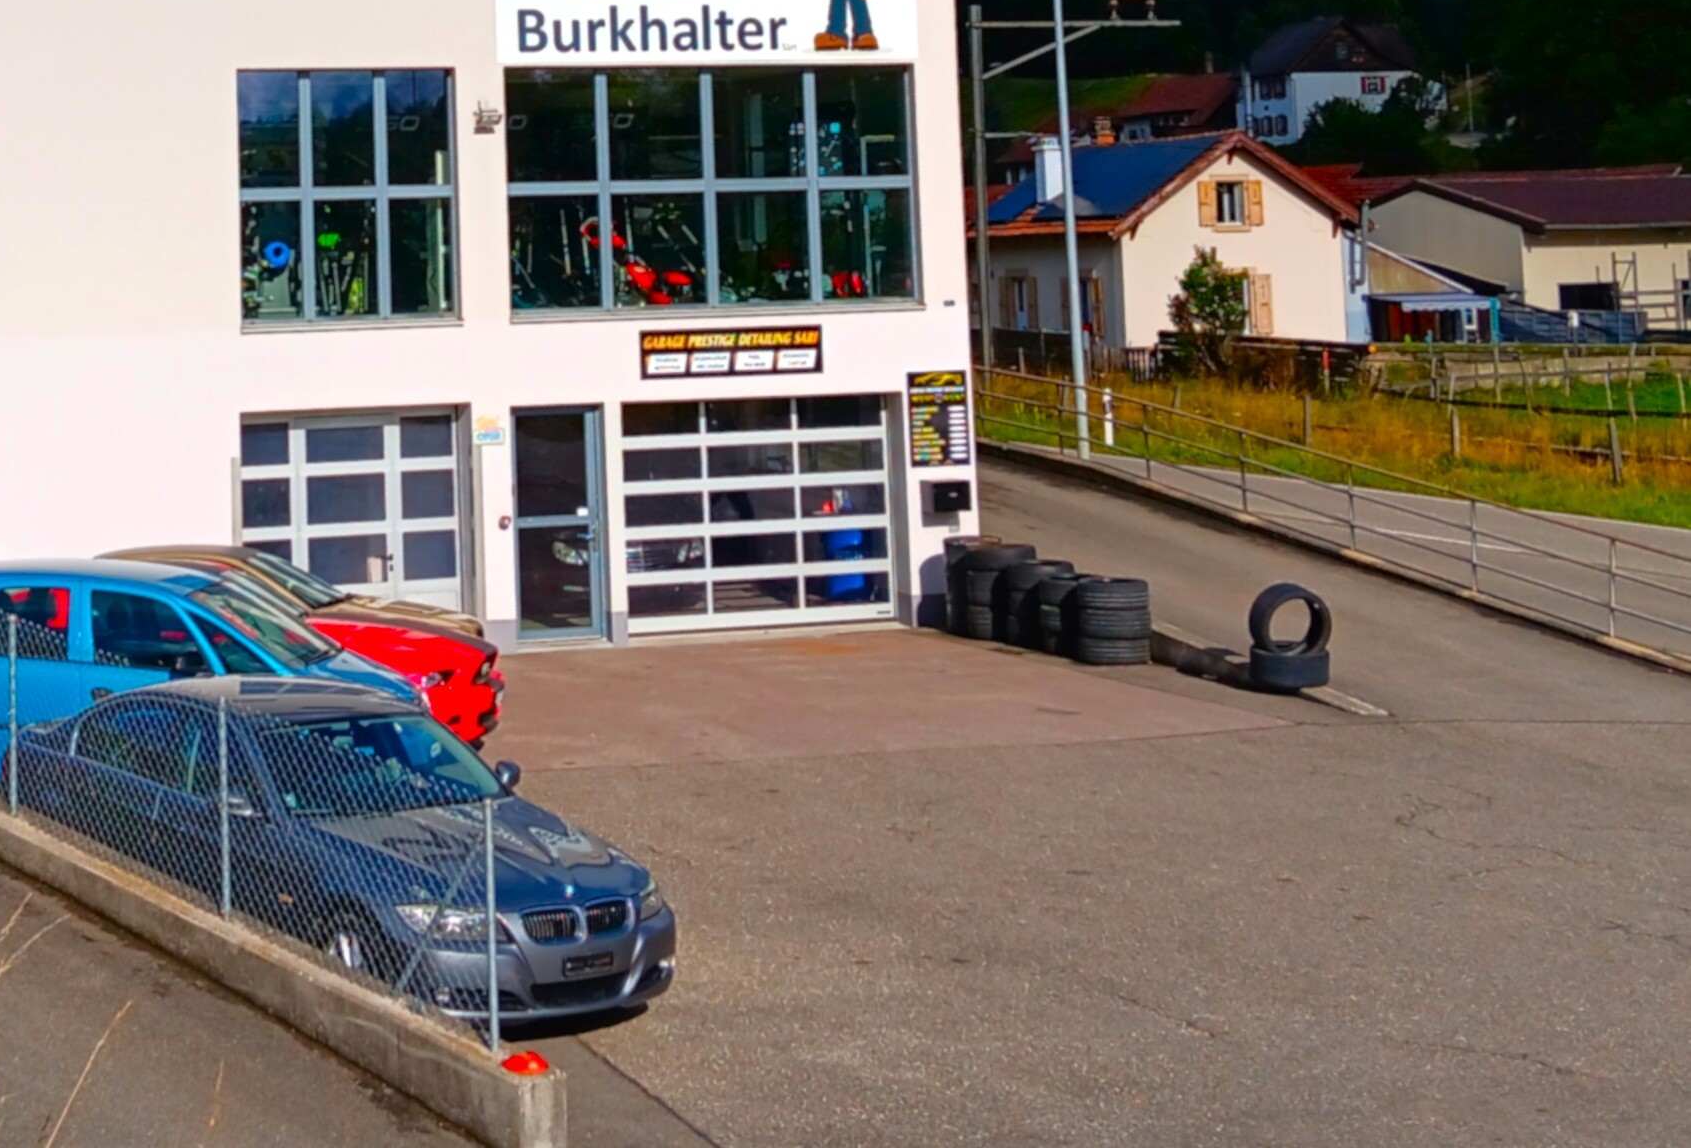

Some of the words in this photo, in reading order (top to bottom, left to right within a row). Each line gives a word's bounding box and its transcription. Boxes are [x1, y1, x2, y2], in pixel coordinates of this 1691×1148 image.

[517, 4, 787, 53] Burkhalter
[643, 334, 686, 350] GARAGE
[687, 332, 737, 348] PRESTIGE
[738, 330, 792, 347] DETAILING
